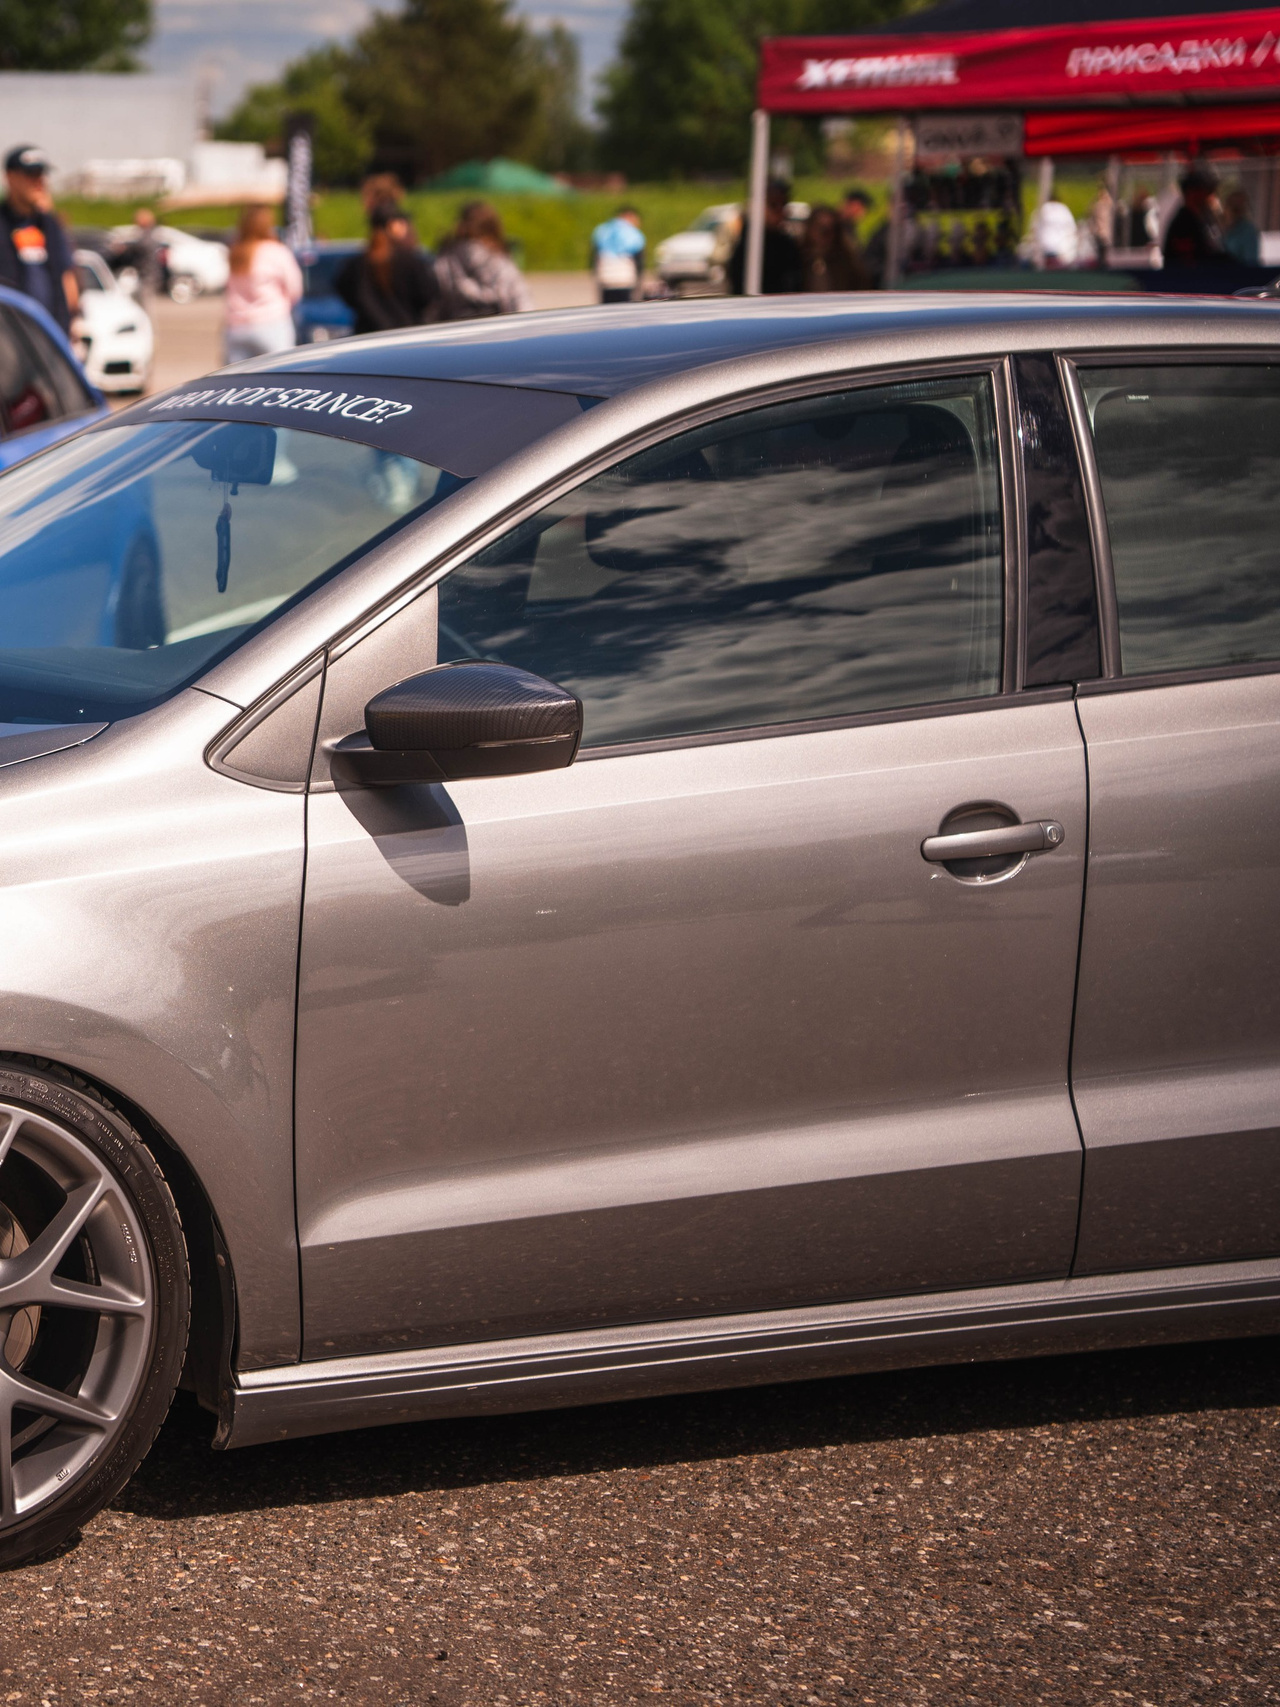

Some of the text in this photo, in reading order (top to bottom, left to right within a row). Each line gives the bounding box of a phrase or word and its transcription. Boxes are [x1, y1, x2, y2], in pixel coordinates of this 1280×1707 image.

[1065, 36, 1248, 78] ПРИСАДКИ
[148, 387, 413, 424] WHY NOT STANCE?
